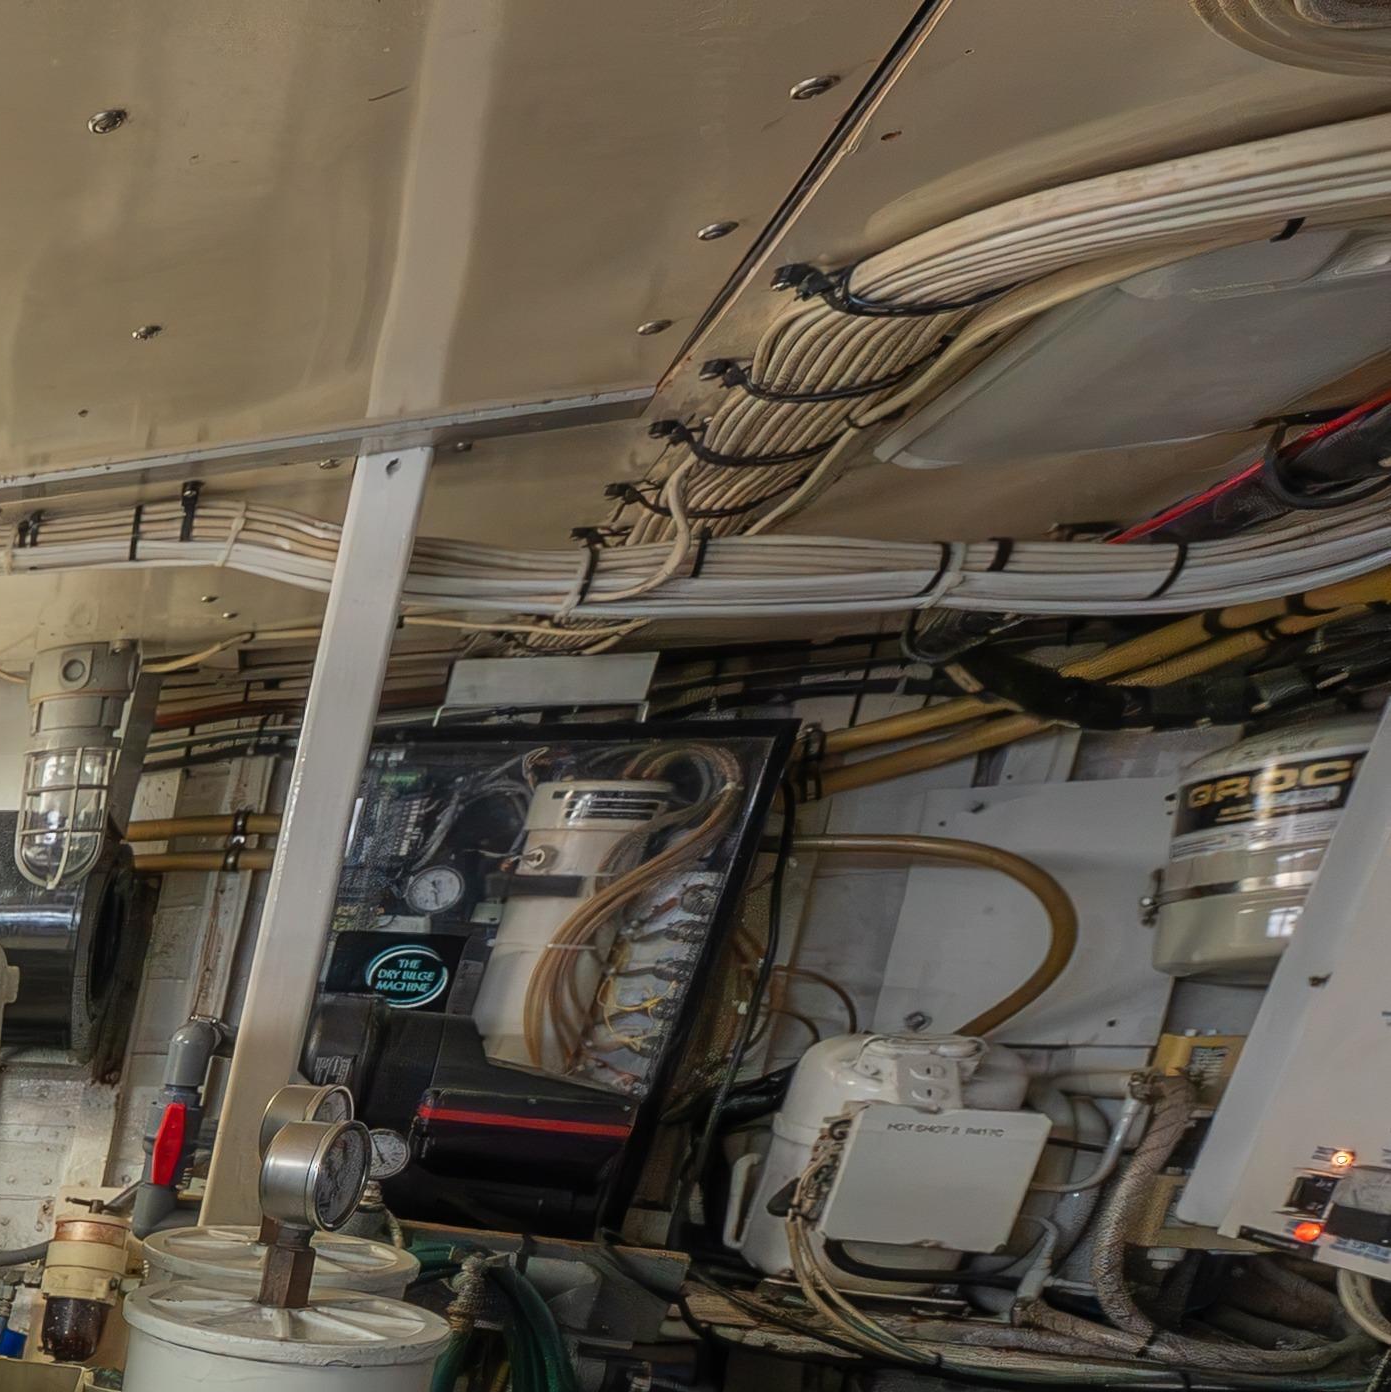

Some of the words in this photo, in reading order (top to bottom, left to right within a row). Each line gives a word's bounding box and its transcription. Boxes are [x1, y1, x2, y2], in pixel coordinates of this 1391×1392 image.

[1188, 759, 1364, 809] GROC
[398, 959, 422, 969] THE
[377, 968, 402, 980] DRY
[375, 980, 431, 992] MACHINE
